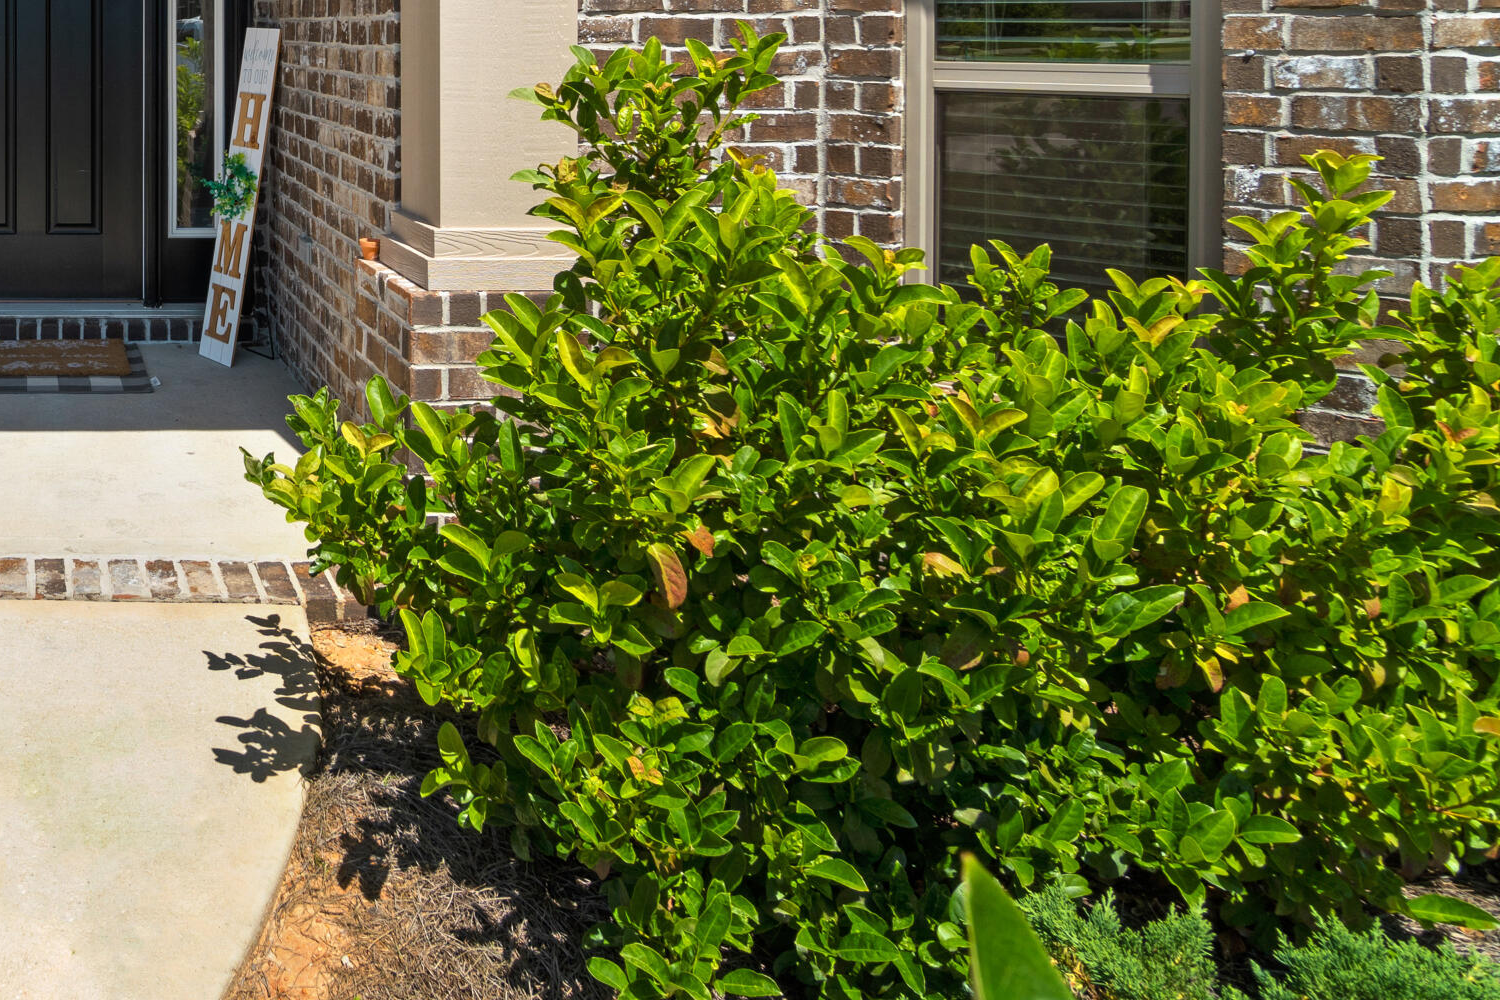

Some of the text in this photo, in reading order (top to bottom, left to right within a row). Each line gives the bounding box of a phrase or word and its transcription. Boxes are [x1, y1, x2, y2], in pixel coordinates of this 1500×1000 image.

[243, 68, 269, 85] TO OUR
[204, 91, 266, 344] HME
